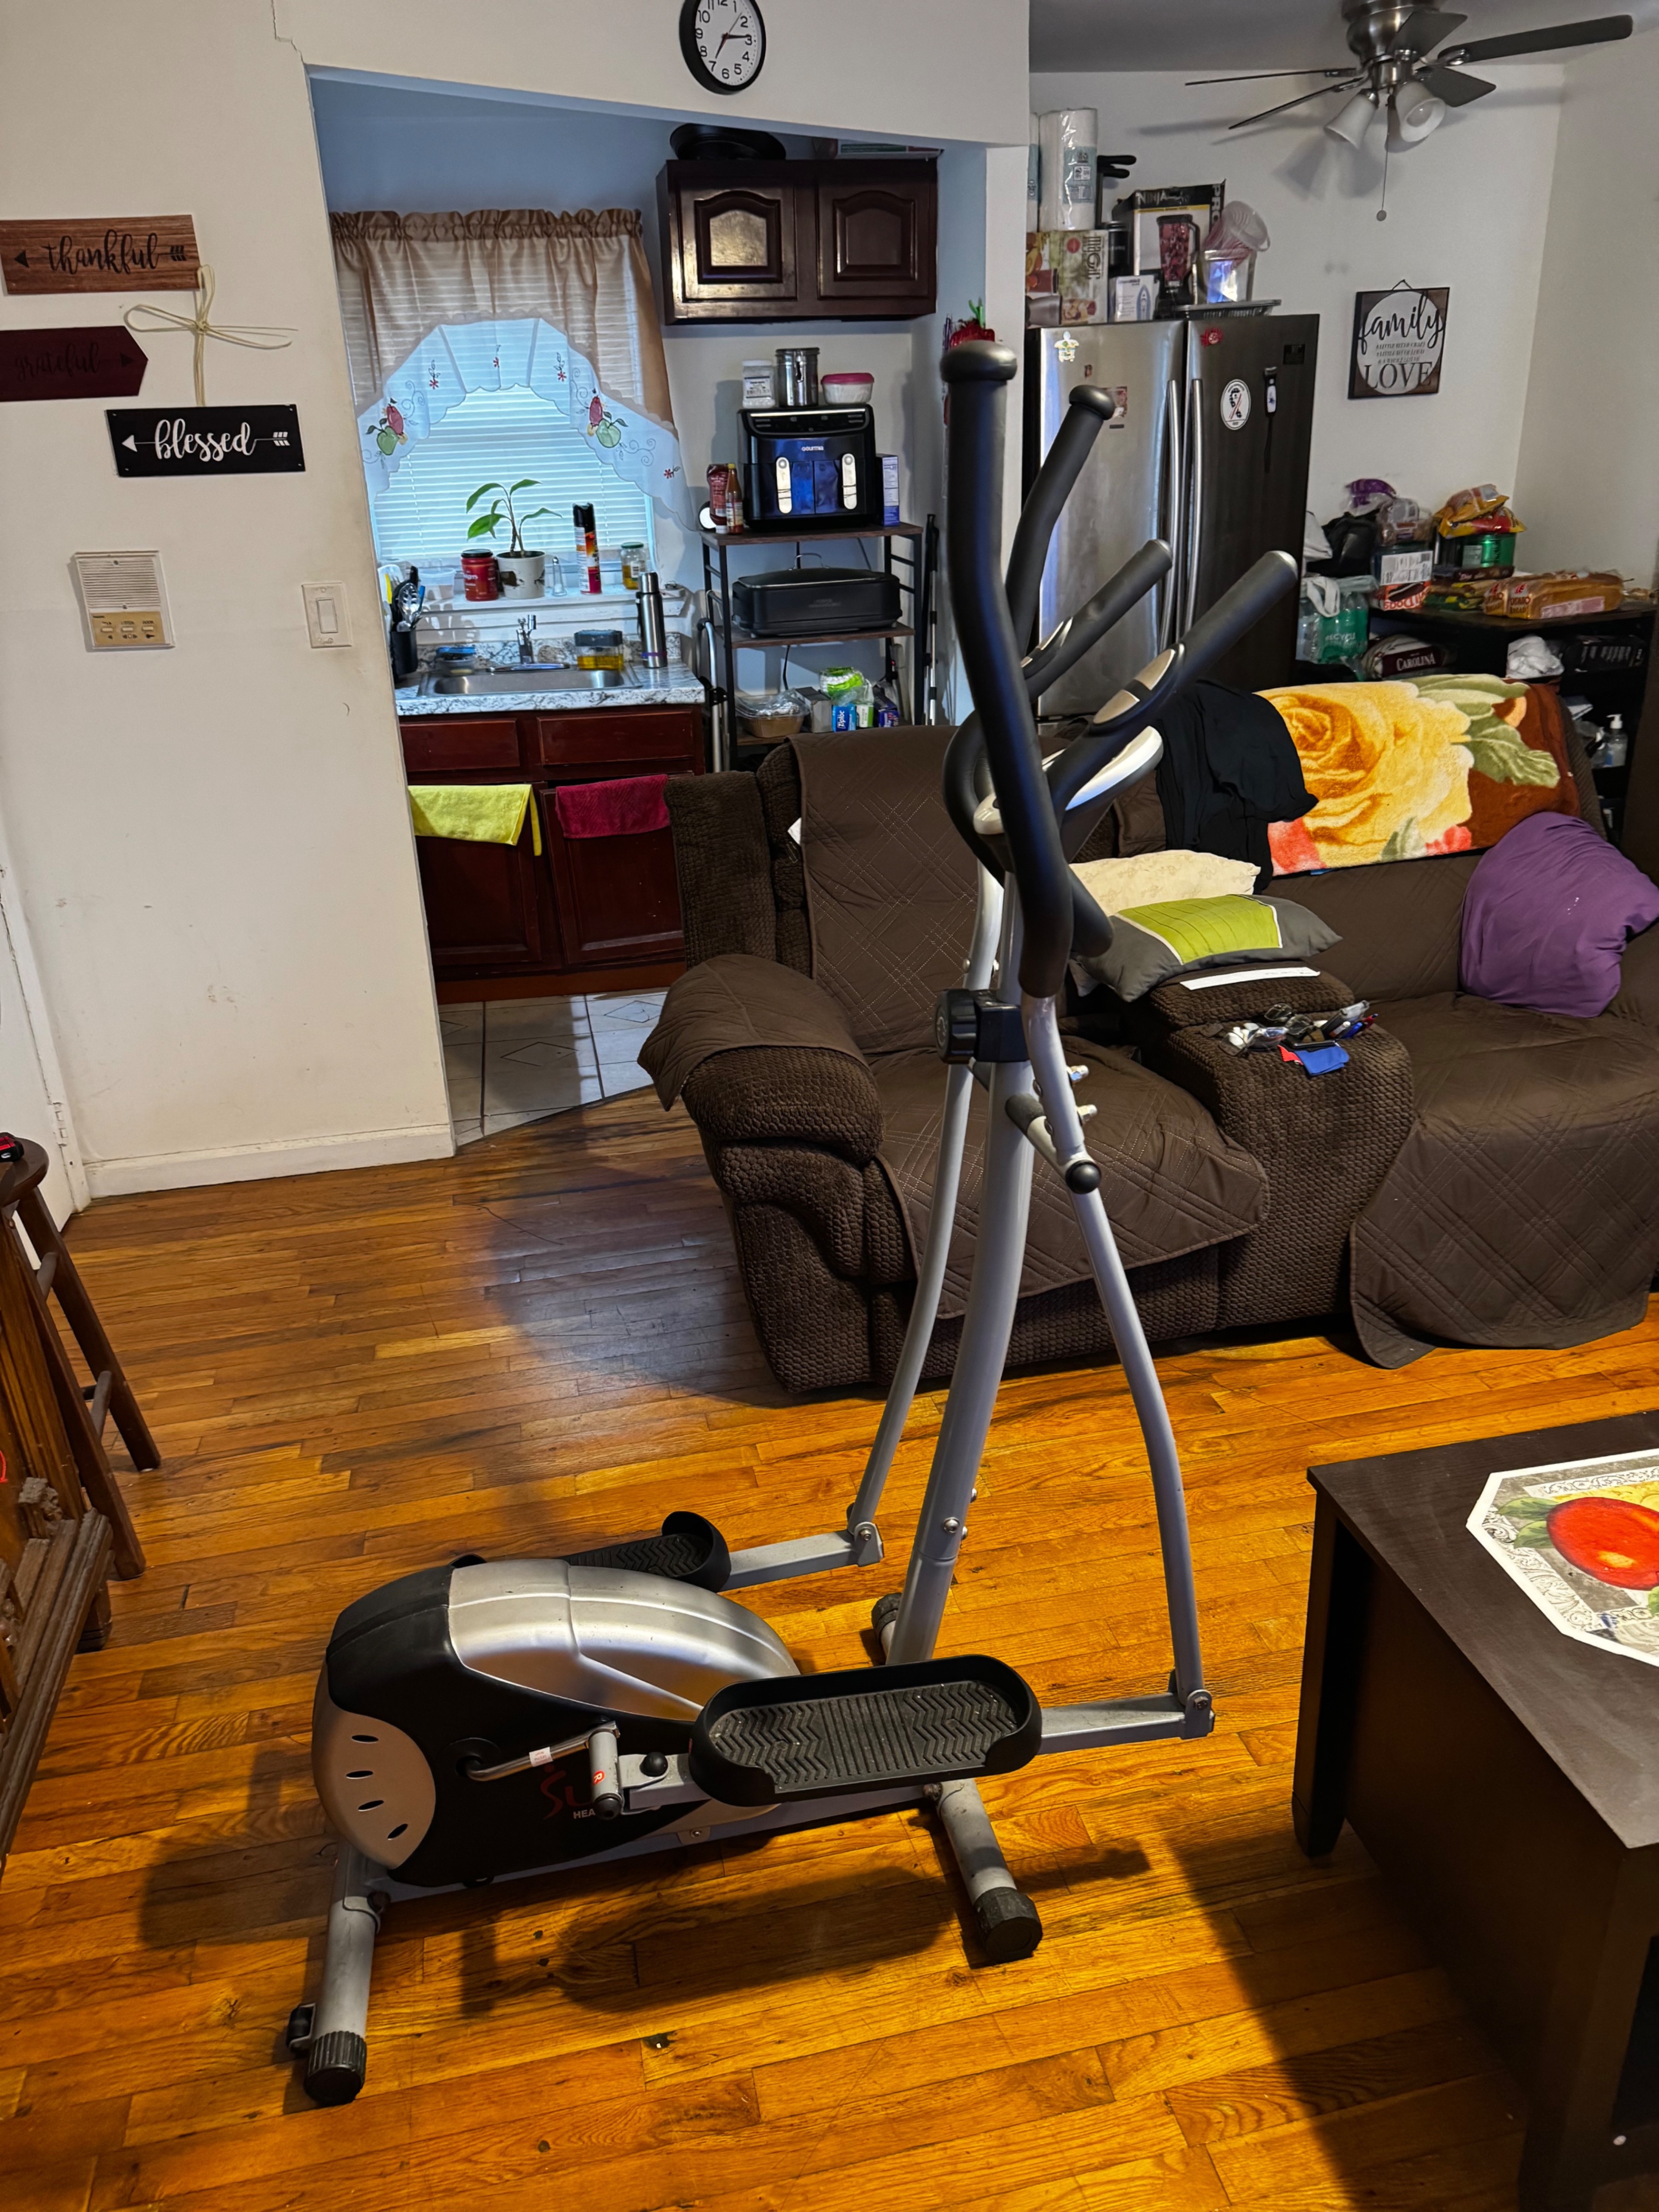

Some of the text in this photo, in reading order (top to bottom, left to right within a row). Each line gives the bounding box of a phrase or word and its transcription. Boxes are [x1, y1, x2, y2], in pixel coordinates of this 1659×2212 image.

[733, 1, 737, 13] 1
[698, 10, 710, 23] 10
[740, 16, 748, 28] 2
[695, 28, 703, 39] 9
[745, 34, 752, 46] 3
[700, 46, 707, 57] 8
[742, 51, 750, 62] 4
[709, 61, 717, 72] 7
[734, 64, 742, 75] 5
[722, 68, 730, 79] 6
[42, 229, 159, 275] thankful
[1358, 290, 1444, 355] family
[15, 340, 101, 383] grateful
[1364, 362, 1432, 389] LOVE
[155, 419, 256, 462] blessed
[1397, 652, 1436, 671] CAROLINA
[837, 710, 846, 728] Ziploc
